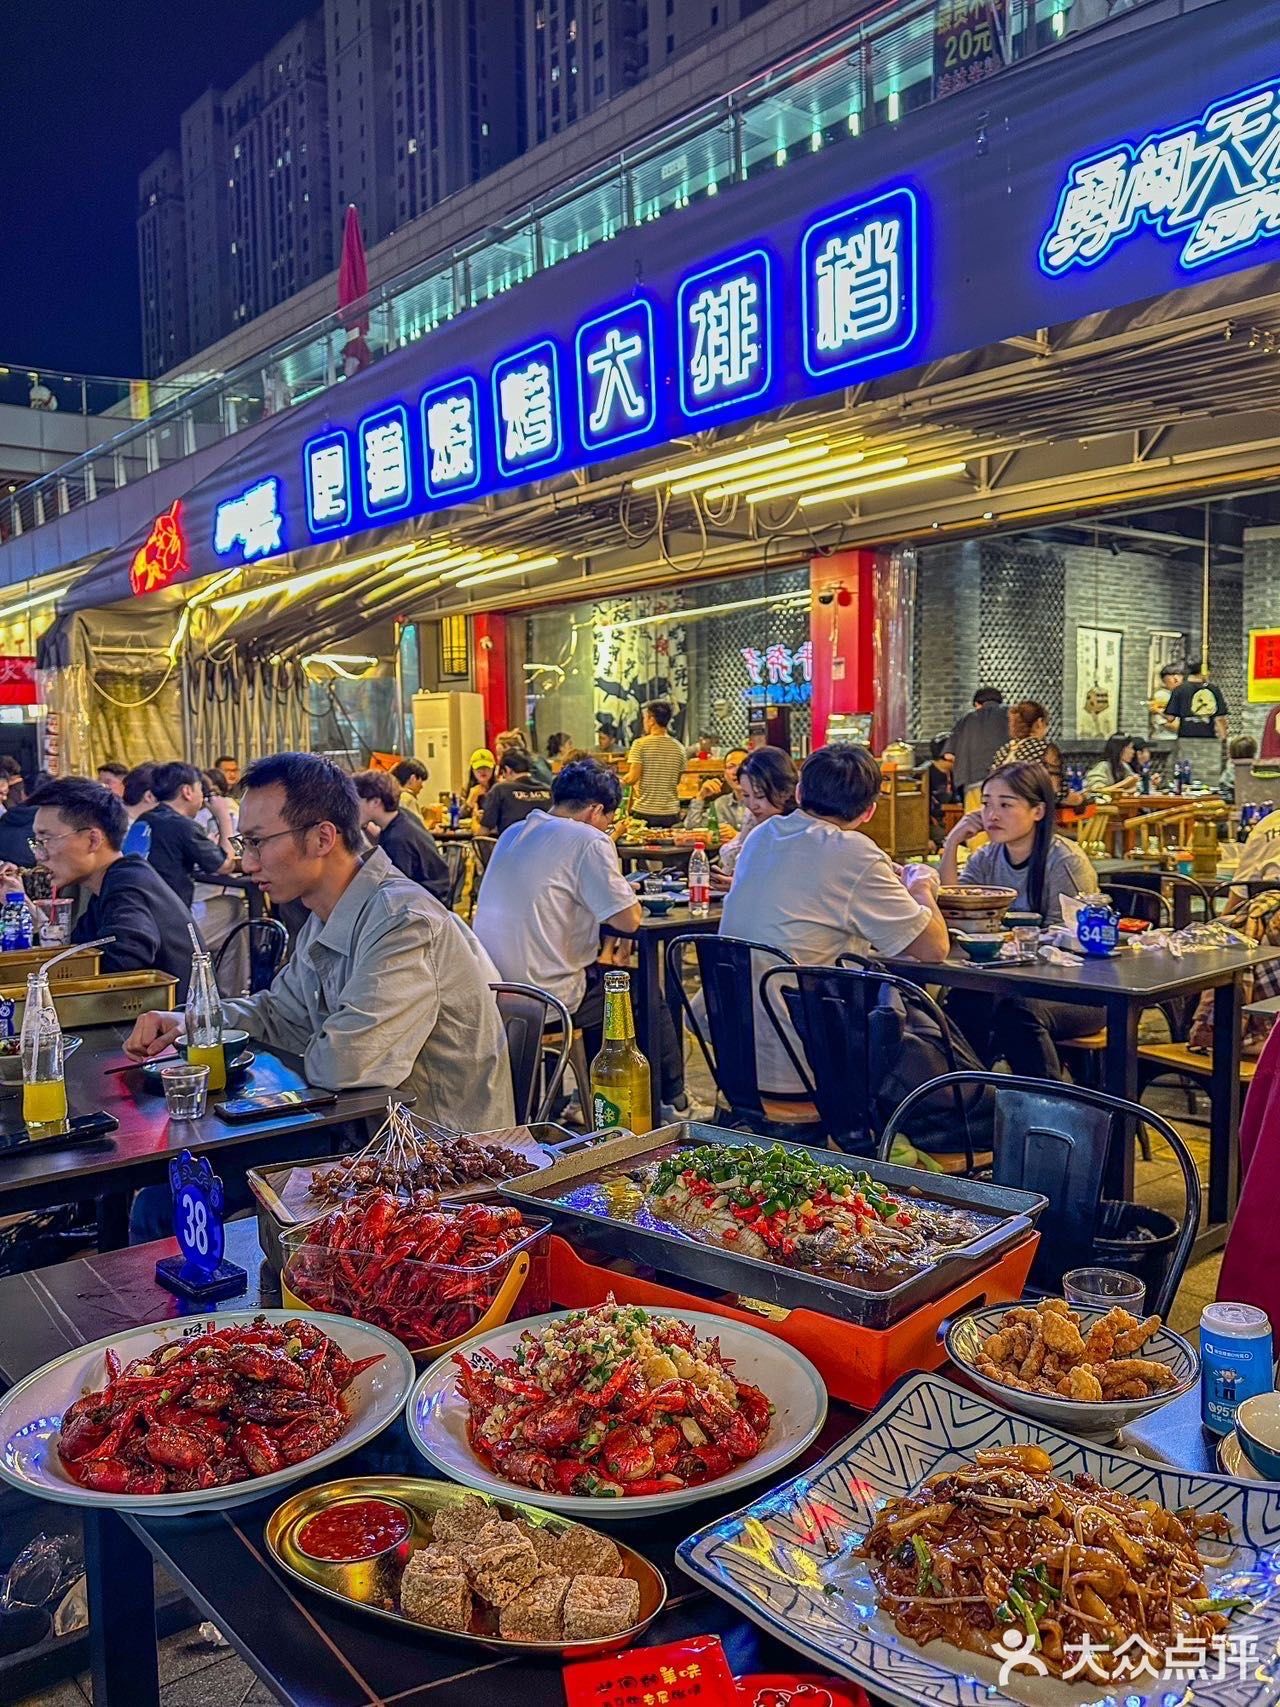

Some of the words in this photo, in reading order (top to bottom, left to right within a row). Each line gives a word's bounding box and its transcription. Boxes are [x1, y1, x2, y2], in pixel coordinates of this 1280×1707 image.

[1047, 90, 1280, 266] 勇闯天
[1079, 925, 1101, 943] 34
[182, 1193, 209, 1255] 38
